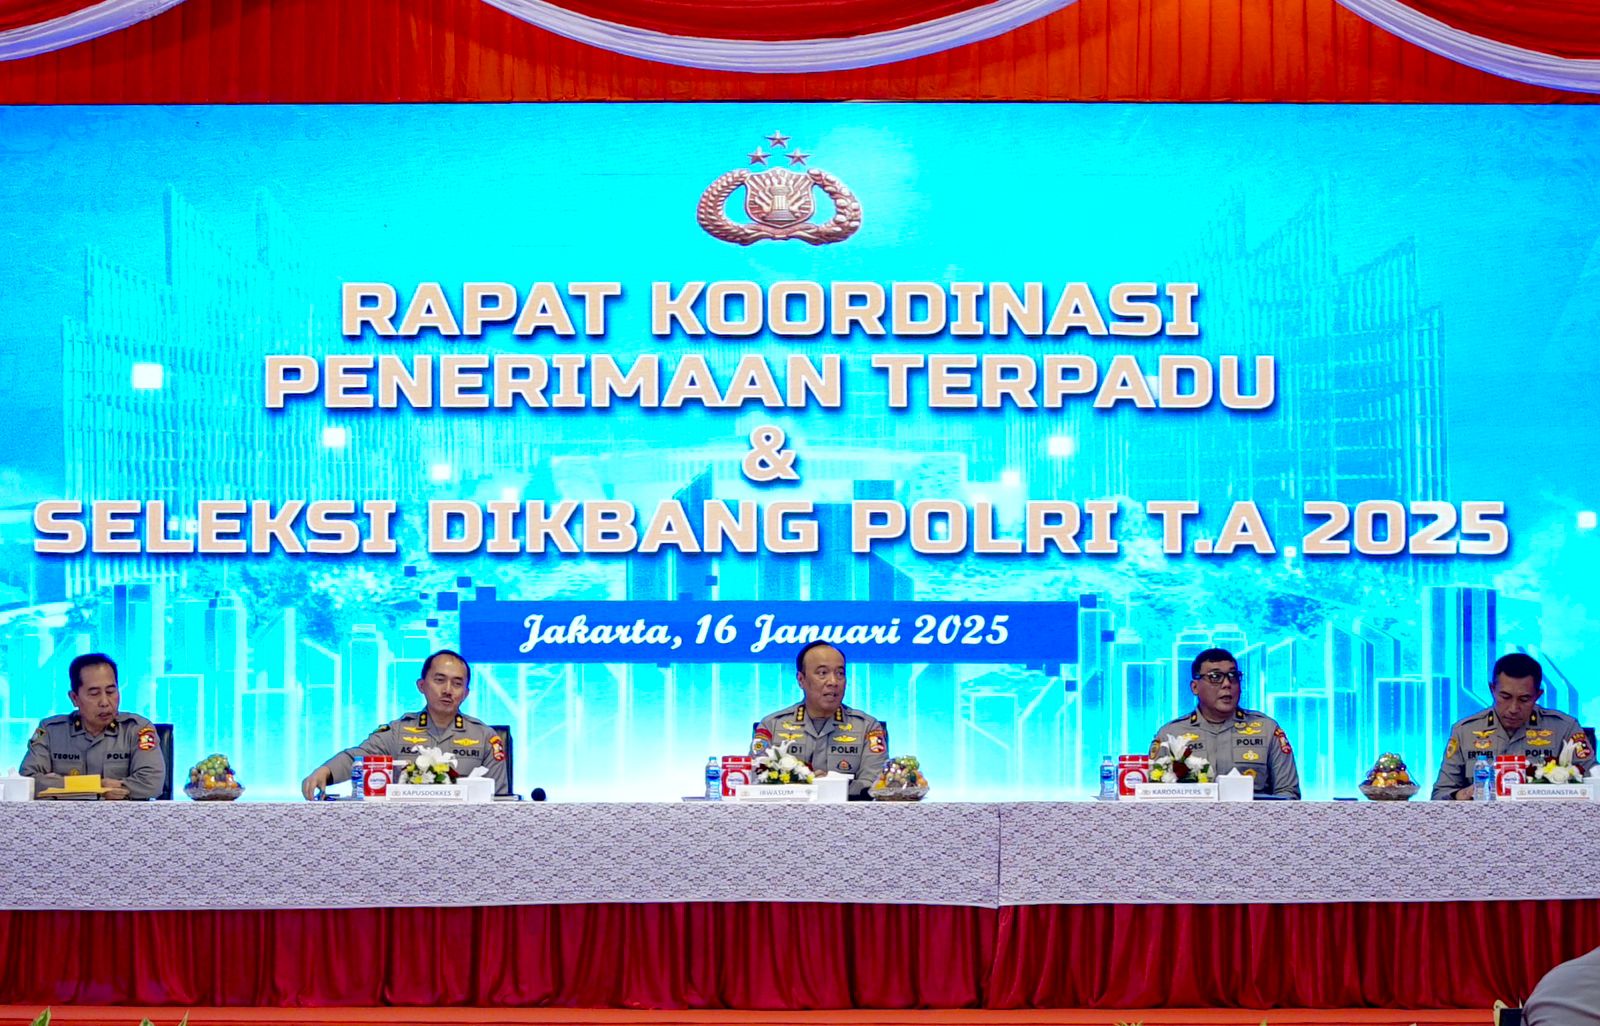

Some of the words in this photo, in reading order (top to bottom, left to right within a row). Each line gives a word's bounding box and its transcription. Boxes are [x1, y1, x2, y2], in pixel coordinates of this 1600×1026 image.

[342, 281, 622, 336] RAPAT
[651, 281, 1200, 336] KOORDINASI
[264, 354, 841, 409] PENERIMAAN
[871, 354, 1276, 409] TERPADU
[741, 425, 800, 481] &
[33, 499, 397, 554] SELEKSI
[427, 499, 819, 554] DIKBANG
[851, 499, 1118, 554] POLRI
[1146, 499, 1276, 555] T.A
[1302, 500, 1509, 555] 2025
[519, 613, 683, 653] Jakarta,
[695, 613, 738, 645] 16
[750, 612, 901, 653] Januari
[912, 613, 1010, 645] 2025
[1236, 738, 1263, 746] POLRI
[452, 749, 480, 757] POLRI
[830, 745, 859, 754] POLRI
[1525, 749, 1553, 758] POLRI
[53, 752, 80, 760] TEGUH
[1151, 788, 1202, 796] KARODALPERS
